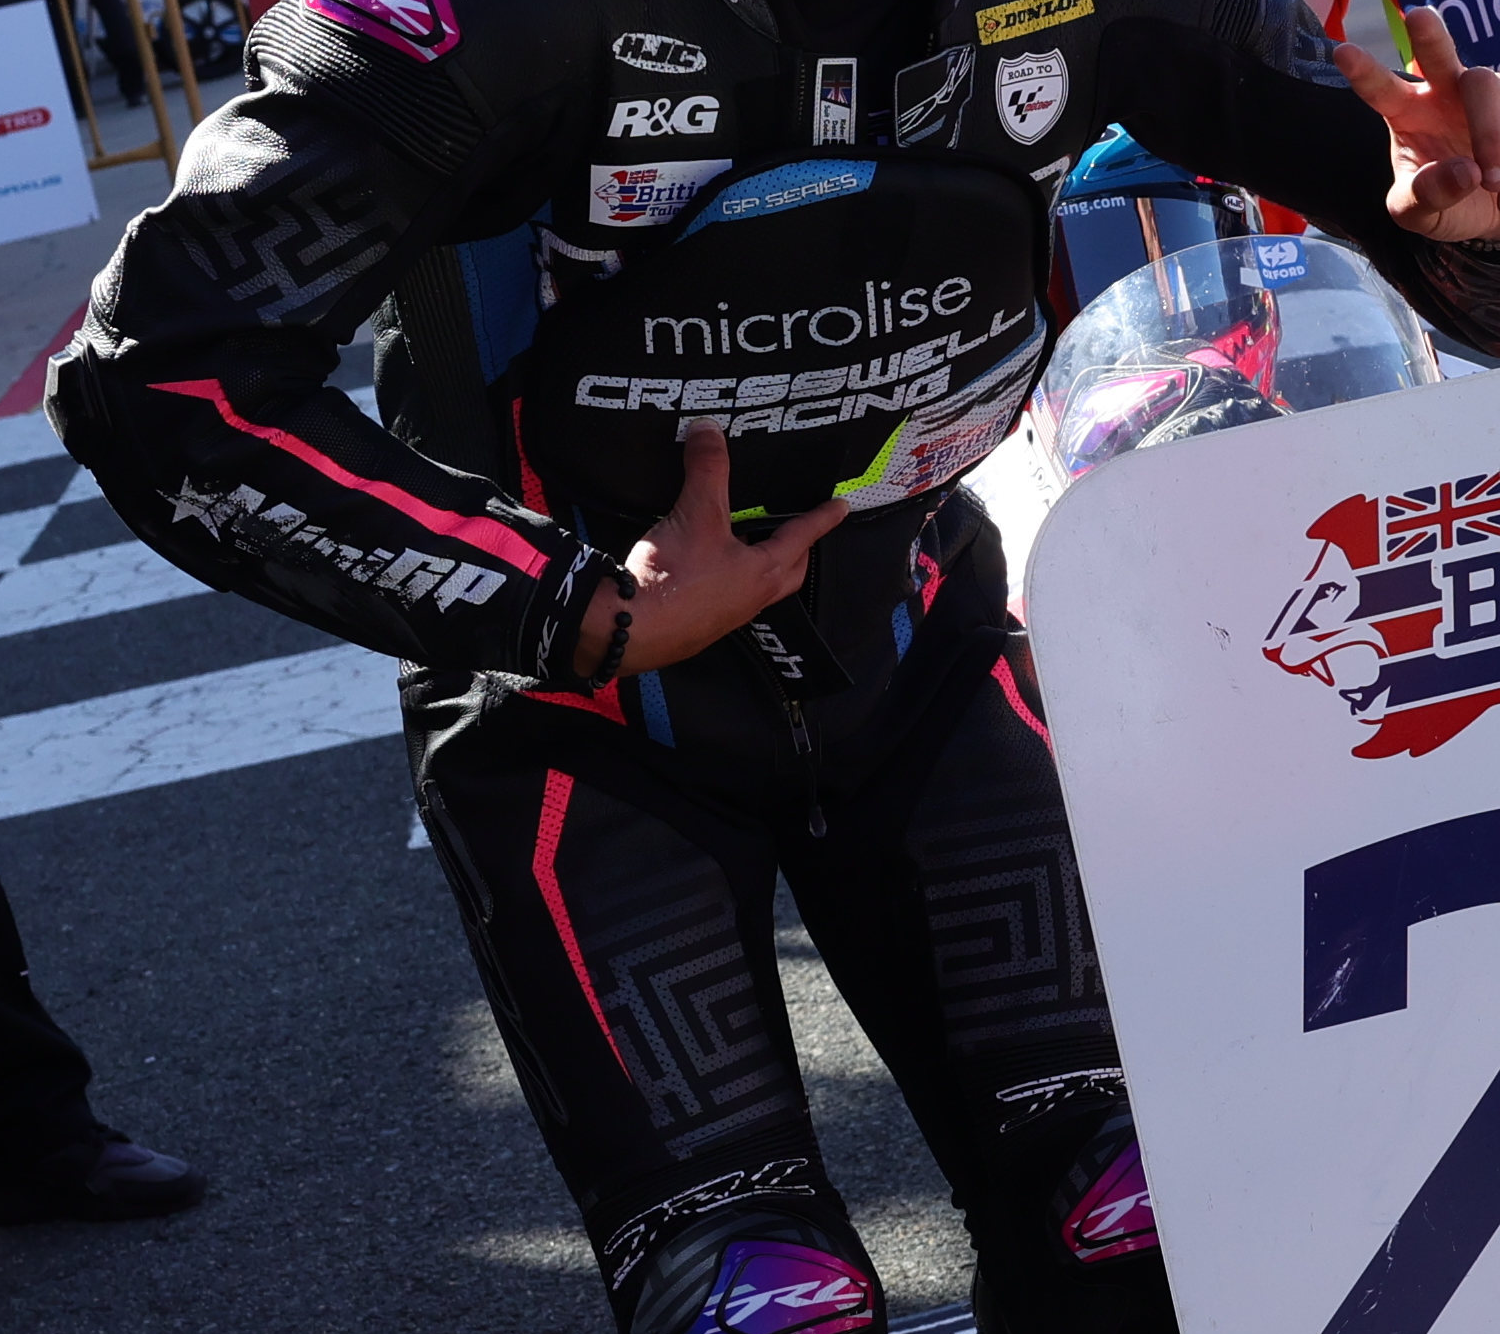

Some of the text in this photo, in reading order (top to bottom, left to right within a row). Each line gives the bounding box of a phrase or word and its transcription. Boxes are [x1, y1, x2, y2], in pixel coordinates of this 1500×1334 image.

[619, 35, 700, 67] HJC
[1008, 64, 1053, 81] ROAD TO
[607, 95, 721, 138] R&G
[636, 181, 700, 204] Briti
[722, 172, 858, 216] GP SERIES
[1225, 197, 1244, 211] HJC
[1262, 265, 1306, 282] OXFORD
[644, 276, 973, 356] microlise
[575, 306, 1028, 413] CRESSWELL
